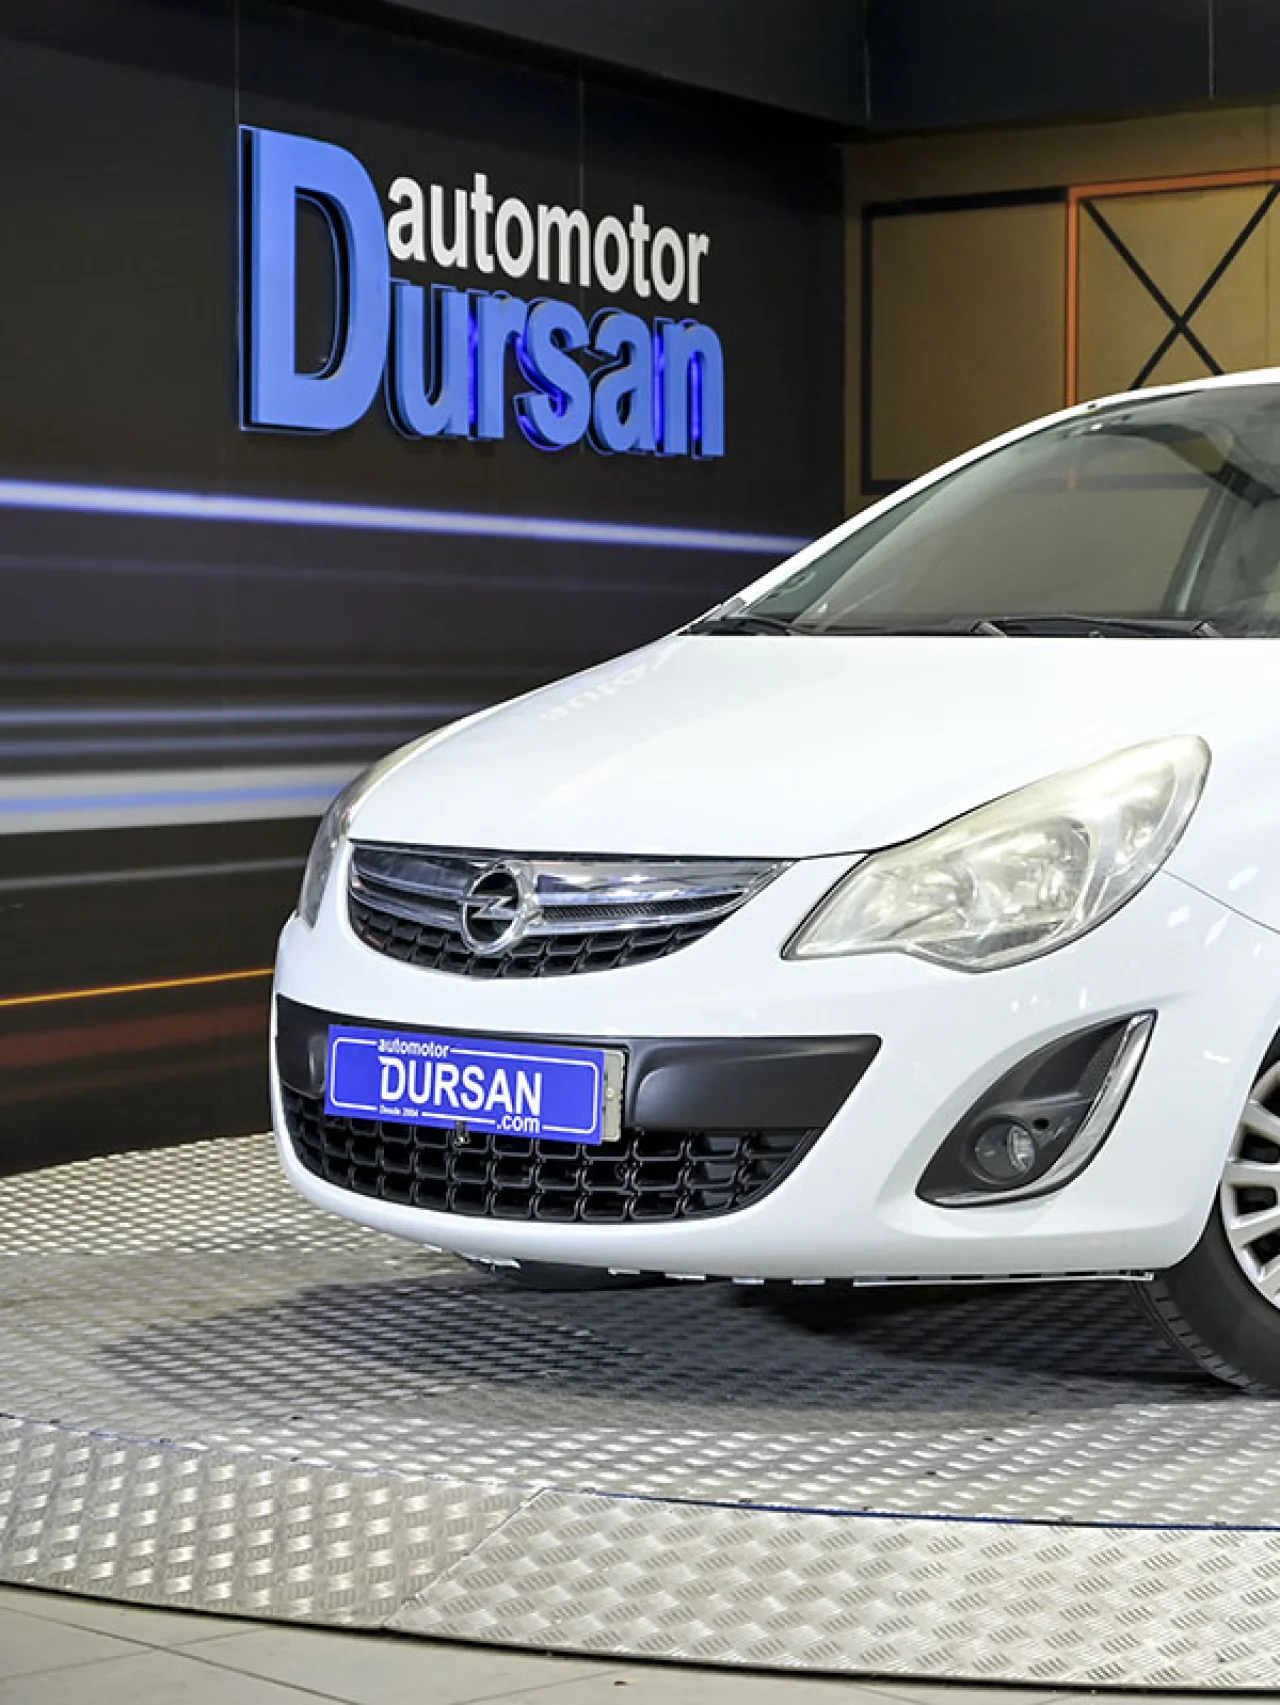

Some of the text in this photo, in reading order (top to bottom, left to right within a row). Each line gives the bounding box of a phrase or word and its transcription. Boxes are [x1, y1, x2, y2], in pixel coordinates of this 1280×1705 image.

[387, 172, 709, 303] automotor
[239, 124, 724, 460] Dursan
[378, 1037, 449, 1058] automotor
[378, 1056, 542, 1115] DURSAN
[496, 1114, 541, 1133] .com
